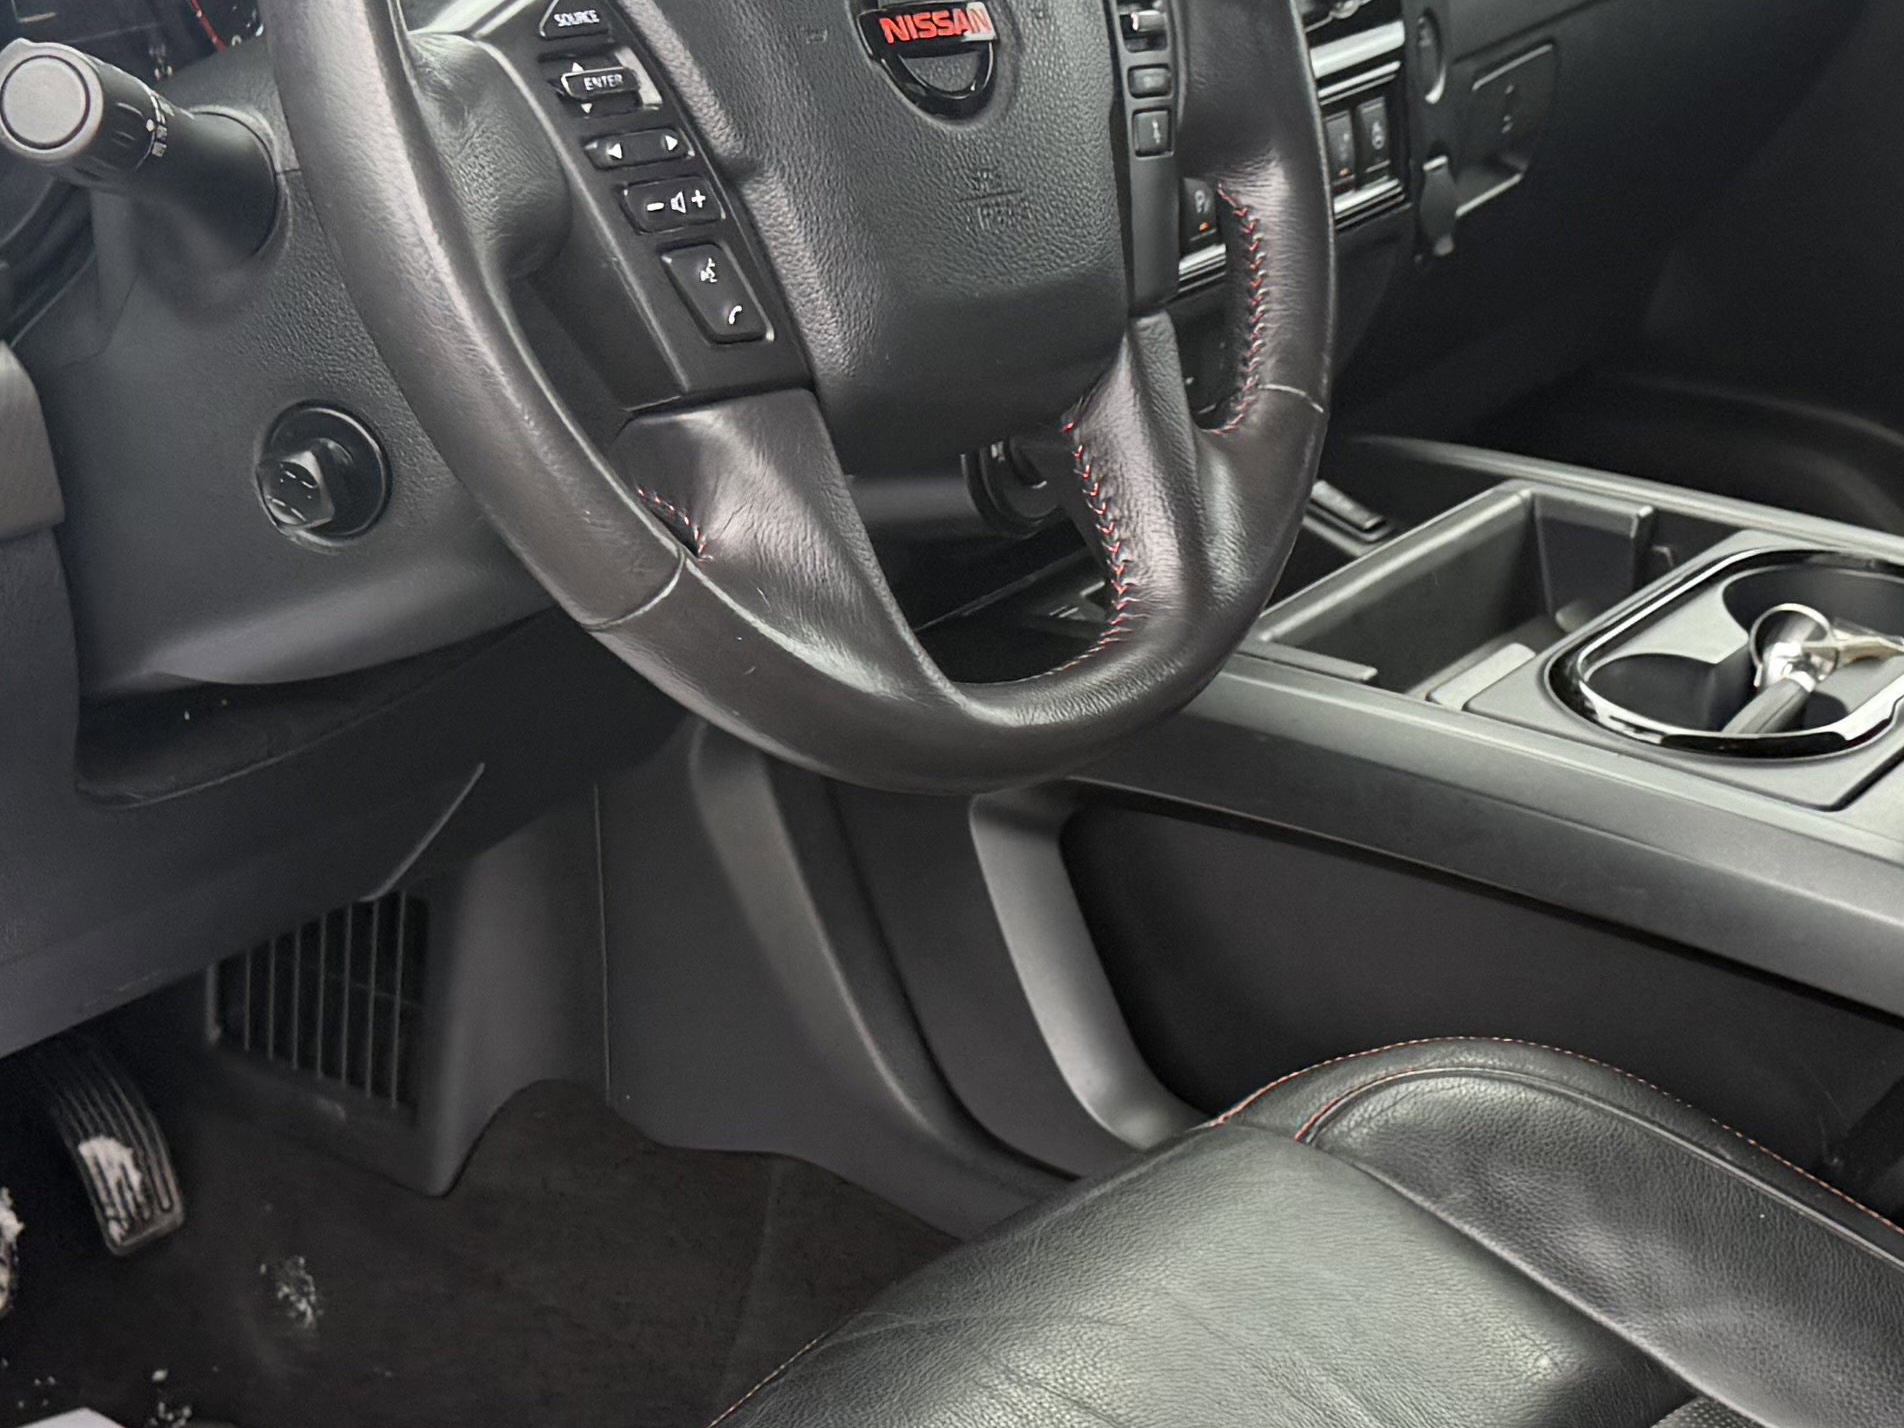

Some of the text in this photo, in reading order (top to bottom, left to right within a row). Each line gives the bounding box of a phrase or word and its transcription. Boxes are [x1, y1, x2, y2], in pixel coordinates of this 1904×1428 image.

[553, 9, 600, 28] SOURCE
[879, 7, 994, 45] NISSAN
[583, 73, 624, 91] ENTER
